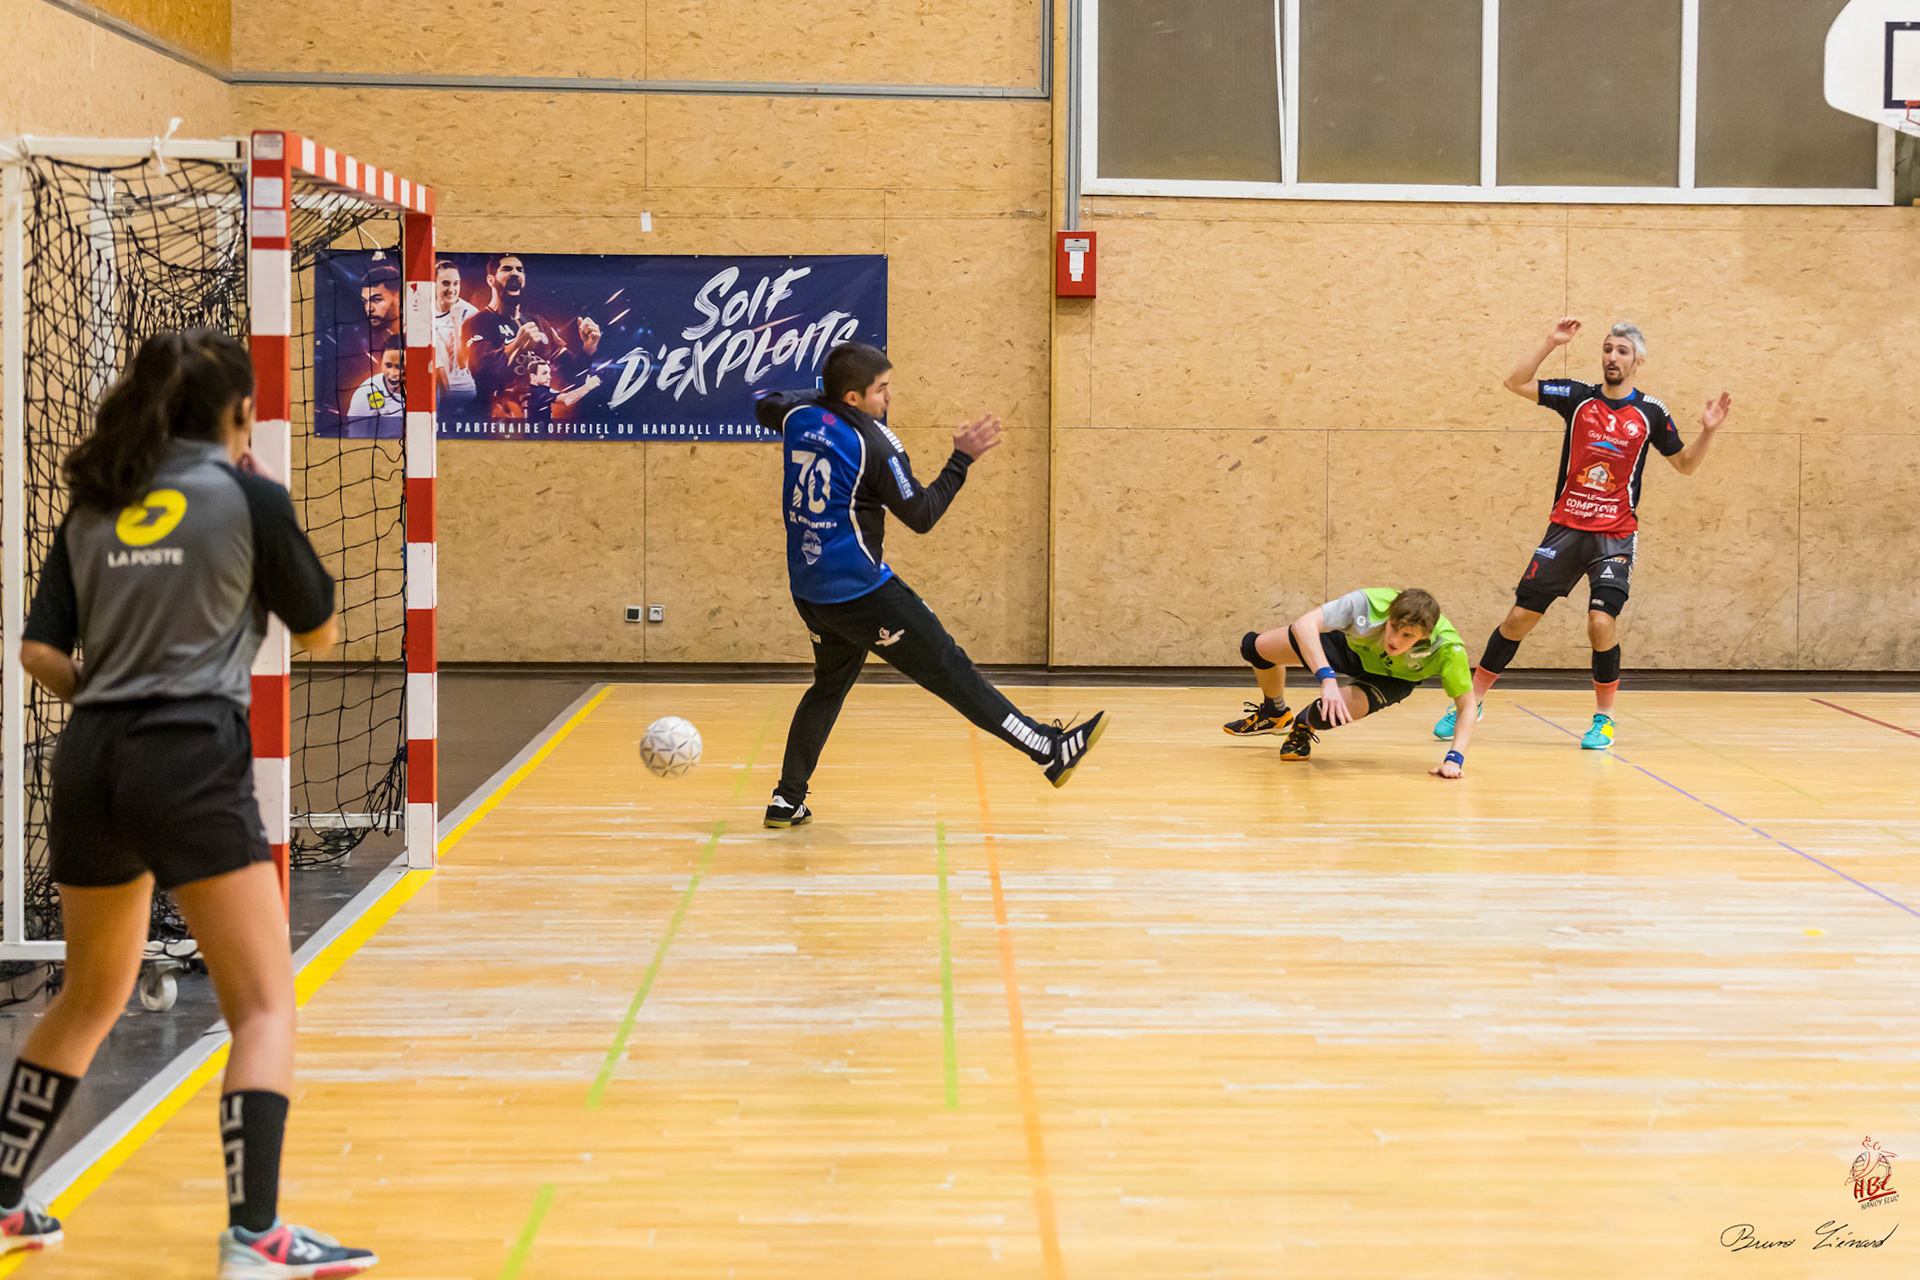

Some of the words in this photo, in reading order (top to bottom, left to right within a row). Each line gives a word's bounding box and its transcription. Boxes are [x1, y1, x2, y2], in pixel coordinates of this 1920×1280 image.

[681, 266, 811, 341] SOIF
[456, 422, 539, 433] PARTENAIRE
[547, 423, 610, 434] OFFICIEL
[618, 423, 634, 434] DU
[642, 423, 711, 435] HANDBALL
[719, 424, 776, 438] FRANÇA
[1605, 414, 1617, 432] 3
[1588, 429, 1603, 441] Guy
[1602, 433, 1629, 447] Hoquet
[791, 450, 832, 514] 70
[1566, 498, 1618, 514] COMPTOIR
[1586, 493, 1596, 501] LE
[107, 550, 129, 568] LA
[130, 548, 184, 566] POSTE
